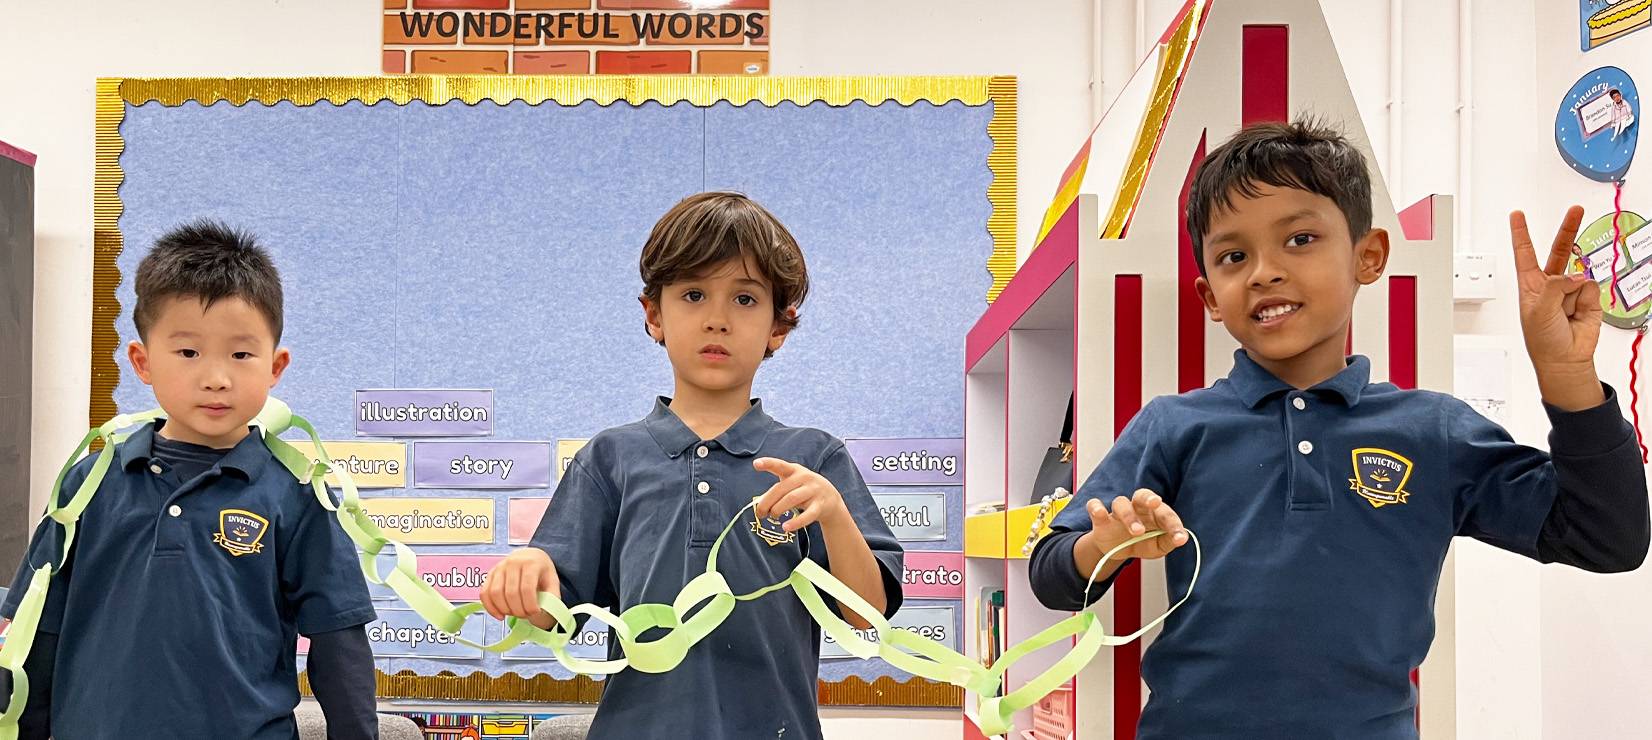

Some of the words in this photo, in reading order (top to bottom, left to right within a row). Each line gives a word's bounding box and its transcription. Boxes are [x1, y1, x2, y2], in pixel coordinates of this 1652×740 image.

[400, 11, 619, 39] WONDERFUL
[631, 12, 764, 39] WORDS
[1569, 82, 1609, 116] January
[1590, 228, 1615, 248] June
[360, 402, 488, 422] illustration
[449, 455, 514, 480] story
[872, 449, 957, 476] setting
[1362, 455, 1402, 472] INVICTUS
[227, 515, 261, 529] INVICTUS
[368, 621, 461, 648] chapter
